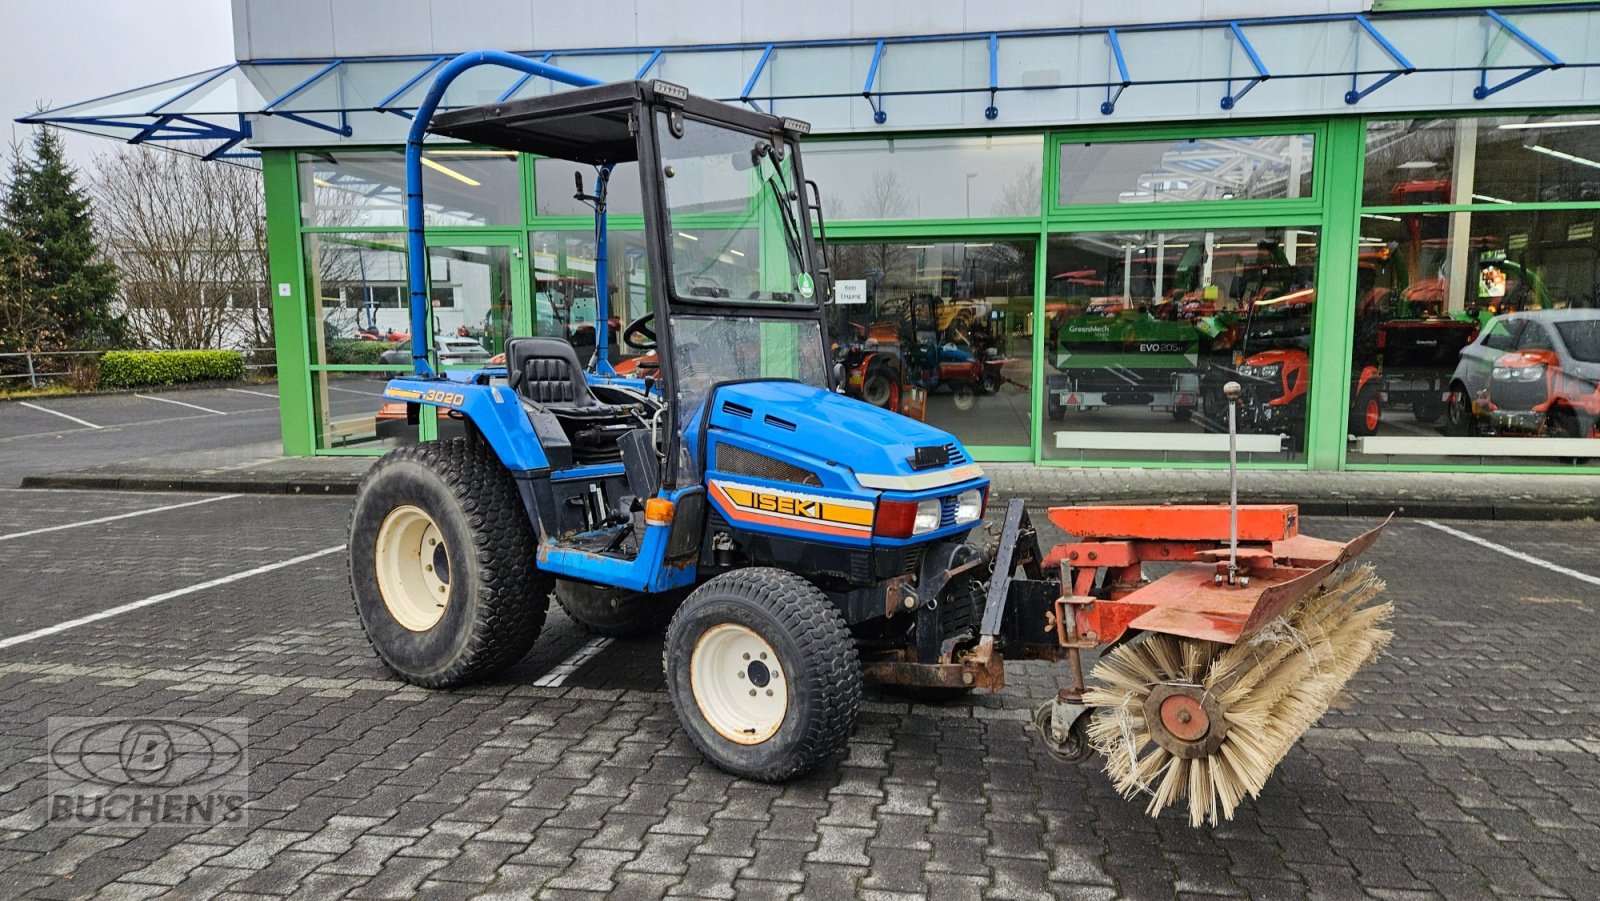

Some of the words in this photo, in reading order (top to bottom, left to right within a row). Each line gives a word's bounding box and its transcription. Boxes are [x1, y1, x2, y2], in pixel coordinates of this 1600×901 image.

[1069, 325, 1110, 333] GreenMech
[1140, 343, 1160, 352] EVO
[425, 389, 464, 406] 3020
[751, 492, 823, 519] ISEKI
